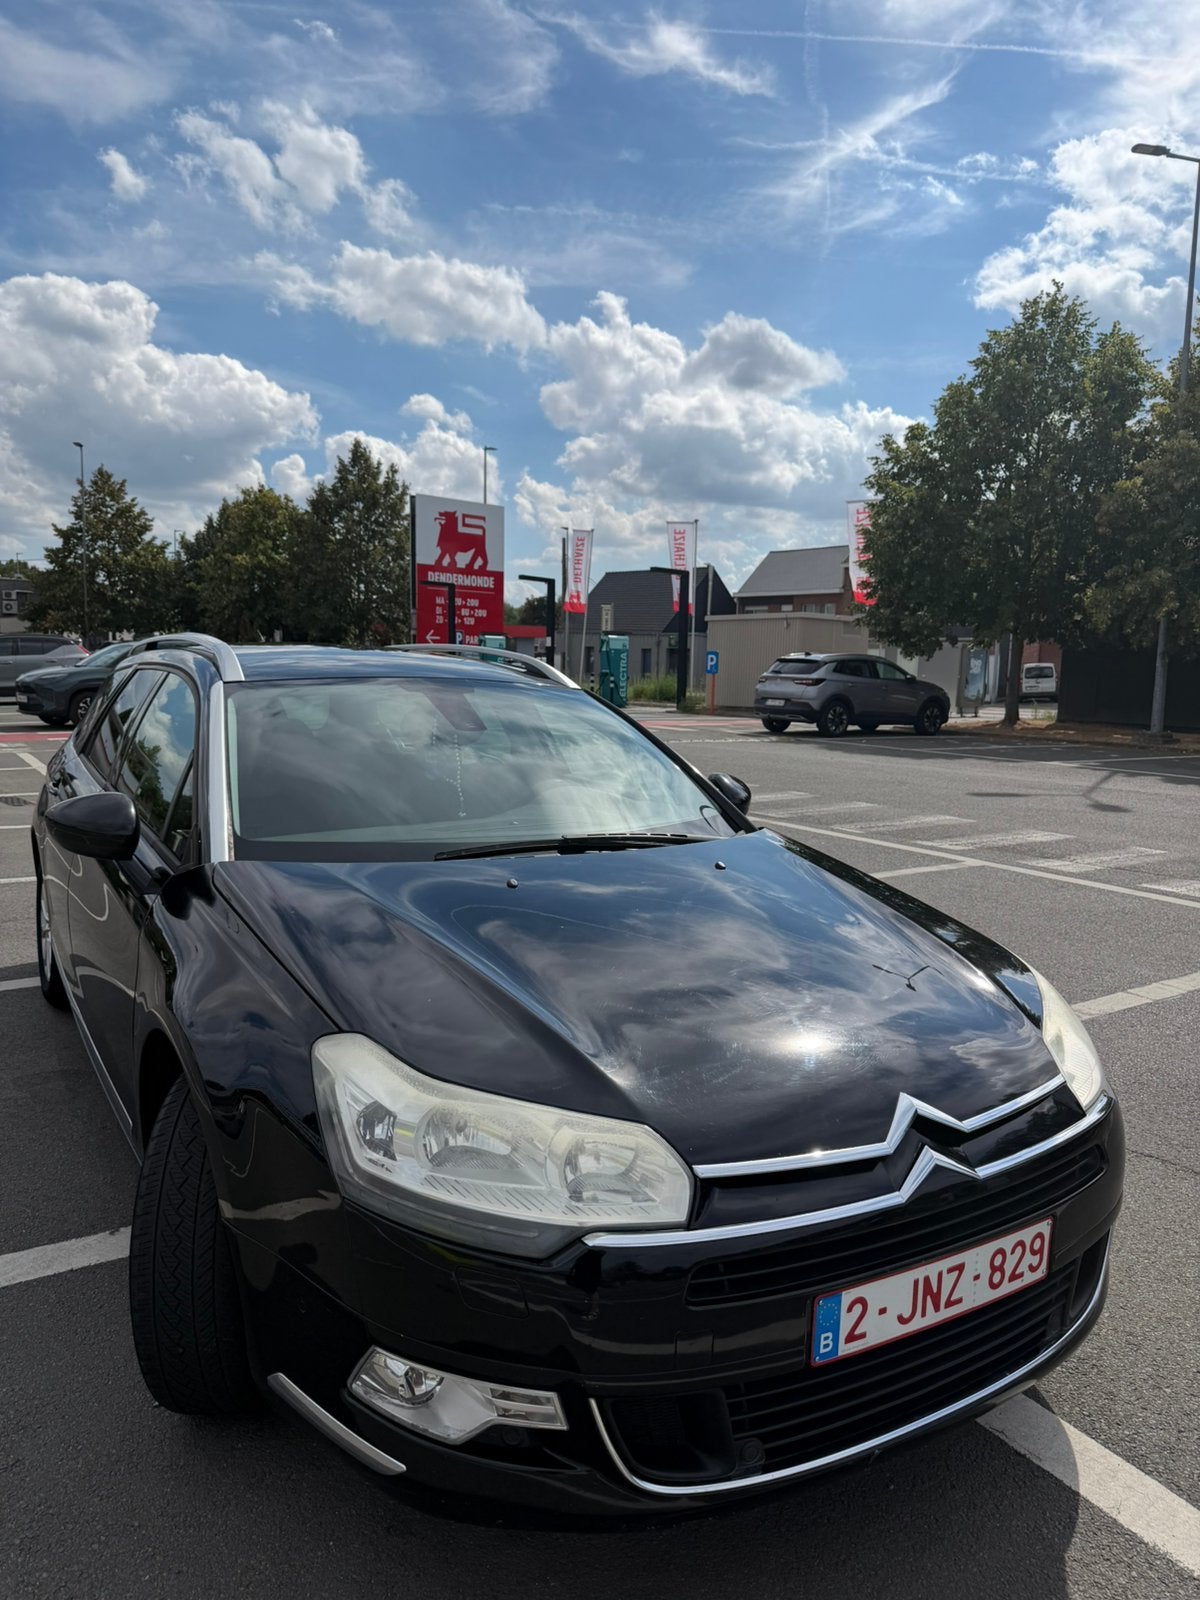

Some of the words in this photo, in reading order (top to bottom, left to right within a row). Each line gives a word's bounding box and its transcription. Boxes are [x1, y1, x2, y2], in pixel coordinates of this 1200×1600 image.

[428, 571, 495, 588] DENDERMONDE
[436, 596, 445, 604] MA
[466, 598, 479, 607] 20U
[474, 608, 487, 617] 20U
[456, 632, 463, 642] P
[708, 654, 717, 670] P
[619, 652, 628, 698] ELECTRA
[844, 1231, 1046, 1345] 2-JNZ-829
[819, 1332, 833, 1354] B
